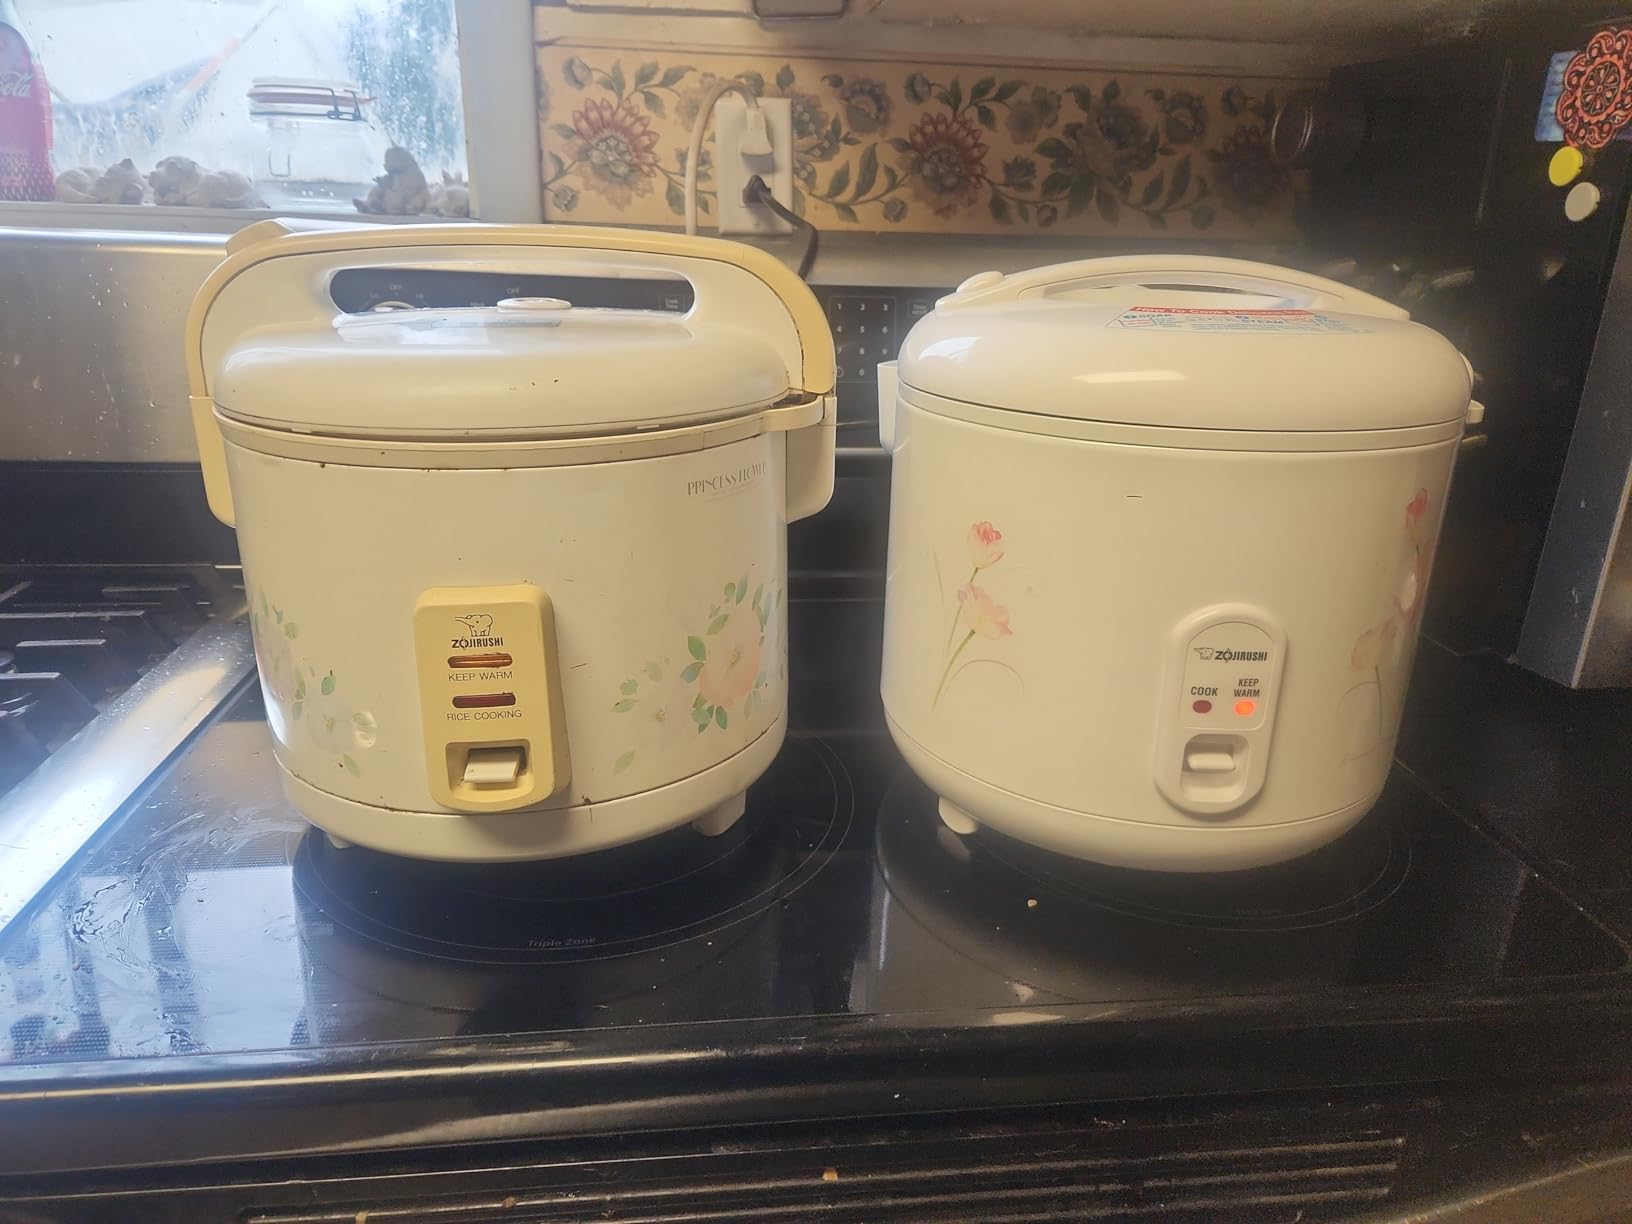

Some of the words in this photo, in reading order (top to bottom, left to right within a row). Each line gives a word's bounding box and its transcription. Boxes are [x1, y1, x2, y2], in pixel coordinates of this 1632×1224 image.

[687, 472, 737, 496] PRINCESS
[451, 636, 504, 651] ZOJIRUSHI
[1214, 647, 1268, 663] ZOJIRUSHI
[448, 673, 475, 682] KEEP
[479, 671, 513, 680] WARM
[1238, 678, 1259, 687] KEEP
[1191, 686, 1218, 697] COOK
[1233, 688, 1260, 698] WARM
[447, 712, 470, 721] RICE
[474, 710, 522, 721] COOKING
[528, 939, 562, 948] Triple
